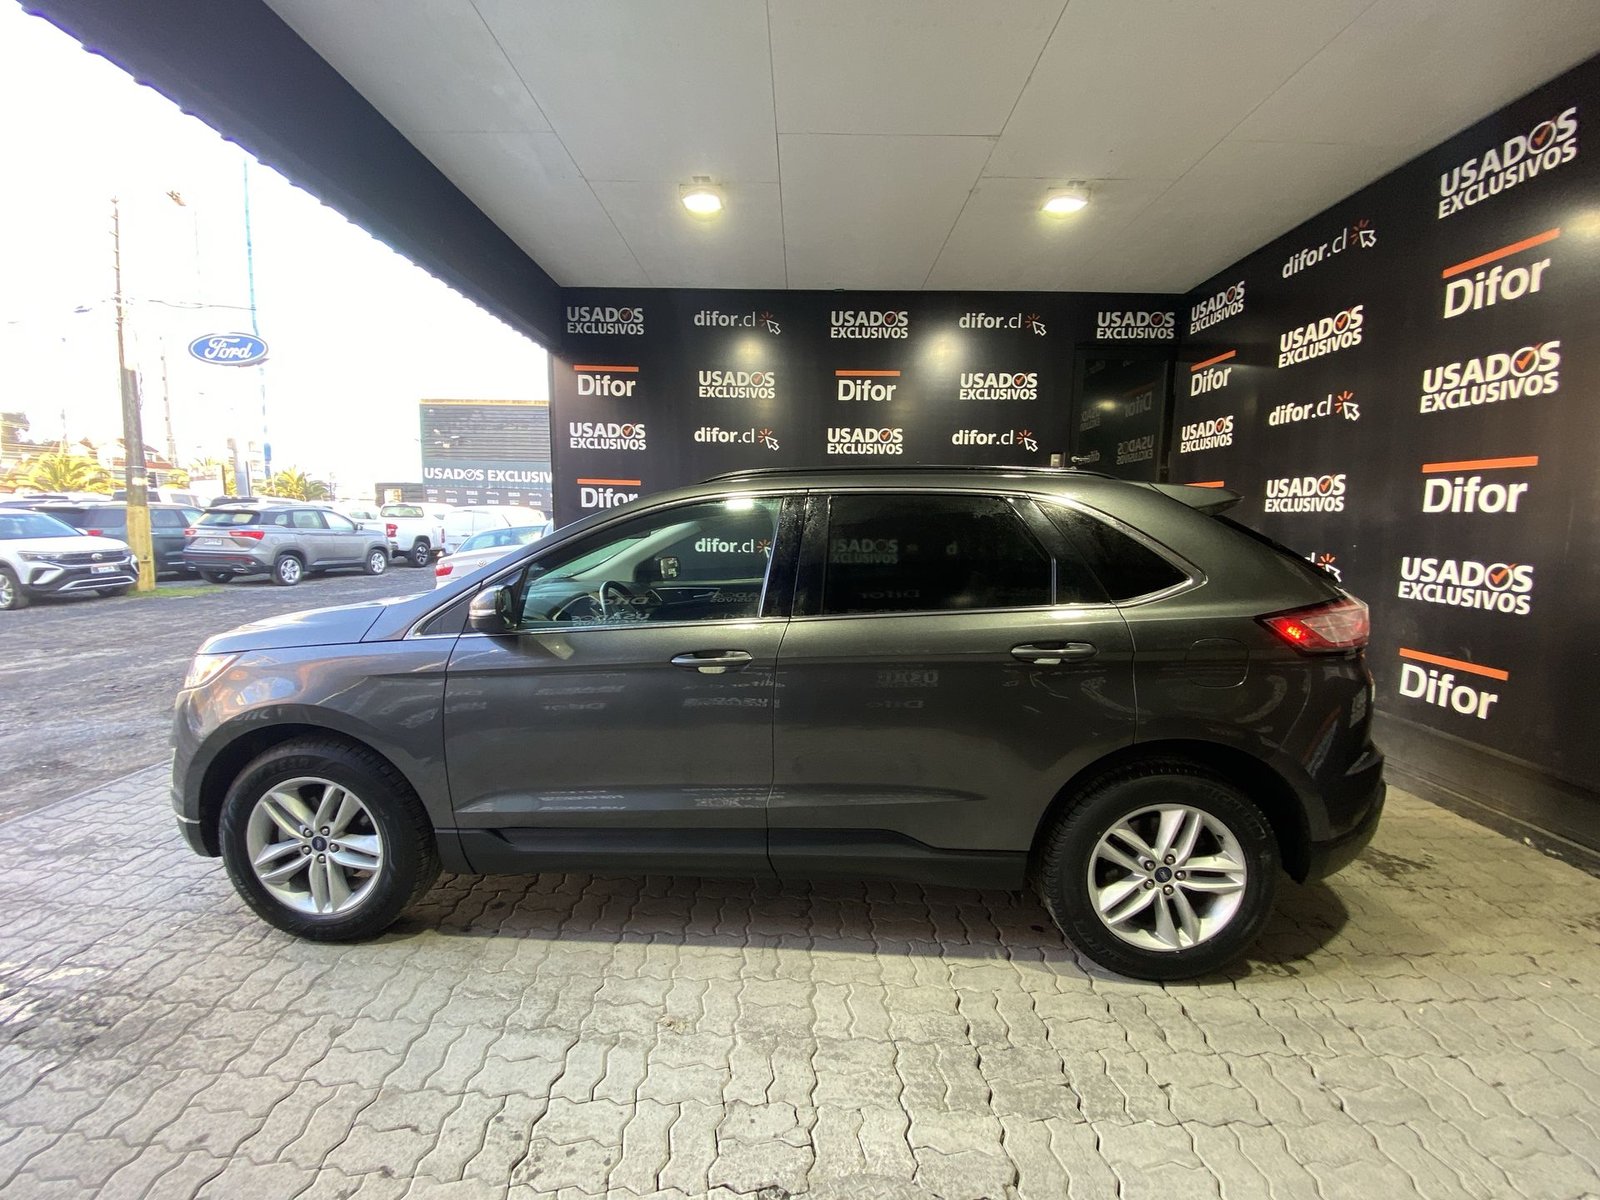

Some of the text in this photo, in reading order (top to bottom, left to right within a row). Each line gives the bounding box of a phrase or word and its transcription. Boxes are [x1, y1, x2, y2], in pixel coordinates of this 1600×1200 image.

[1440, 106, 1578, 198] USADOS
[1438, 138, 1577, 219] EXCLUSIVOS
[1282, 227, 1348, 279] difor.cl
[1444, 258, 1551, 319] Difor
[1191, 280, 1245, 322] USADOS
[567, 306, 644, 324] USADOS
[694, 310, 756, 327] difor.cl
[831, 310, 908, 327] USADOS
[959, 312, 1022, 329] difor.cl
[1097, 311, 1175, 328] USADOS
[1190, 299, 1244, 334] EXCLUSIVOS
[567, 322, 644, 335] EXCLUSIVOS
[831, 326, 909, 339] EXCLUSIVOS
[1096, 326, 1175, 339] EXCLUSIVOS
[1280, 305, 1364, 352] USADOS
[204, 338, 253, 359] Ford
[1278, 328, 1363, 368] EXCLUSIVOS
[1422, 340, 1560, 393] USADOS
[578, 374, 636, 397] Difor
[699, 370, 775, 387] USADOS
[960, 372, 1038, 388] USADOS
[1190, 366, 1232, 396] Difor
[699, 386, 776, 399] EXCLUSIVOS
[838, 379, 896, 401] Difor
[960, 388, 1038, 400] EXCLUSIVOS
[1420, 372, 1559, 413] EXCLUSIVOS
[1268, 393, 1333, 426] difor.cl
[569, 422, 646, 439] USADOS
[694, 427, 755, 443] difor.cl
[827, 428, 903, 443] USADOS
[952, 429, 1014, 445] difor.cl
[1181, 415, 1234, 441] USADOS
[570, 436, 647, 450] EXCLUSIVOS
[827, 442, 903, 455] EXCLUSIVOS
[1180, 433, 1233, 453] EXCLUSIVOS
[424, 467, 484, 481] USADOS
[1266, 474, 1346, 498] USADOS
[1422, 476, 1528, 513] Difor
[1264, 497, 1345, 512] EXCLUSIVOS
[695, 538, 754, 553] difor.cl
[1400, 556, 1534, 593] USADOS
[1398, 581, 1531, 615] EXCLUSIVOS
[1399, 663, 1498, 719] Difor
